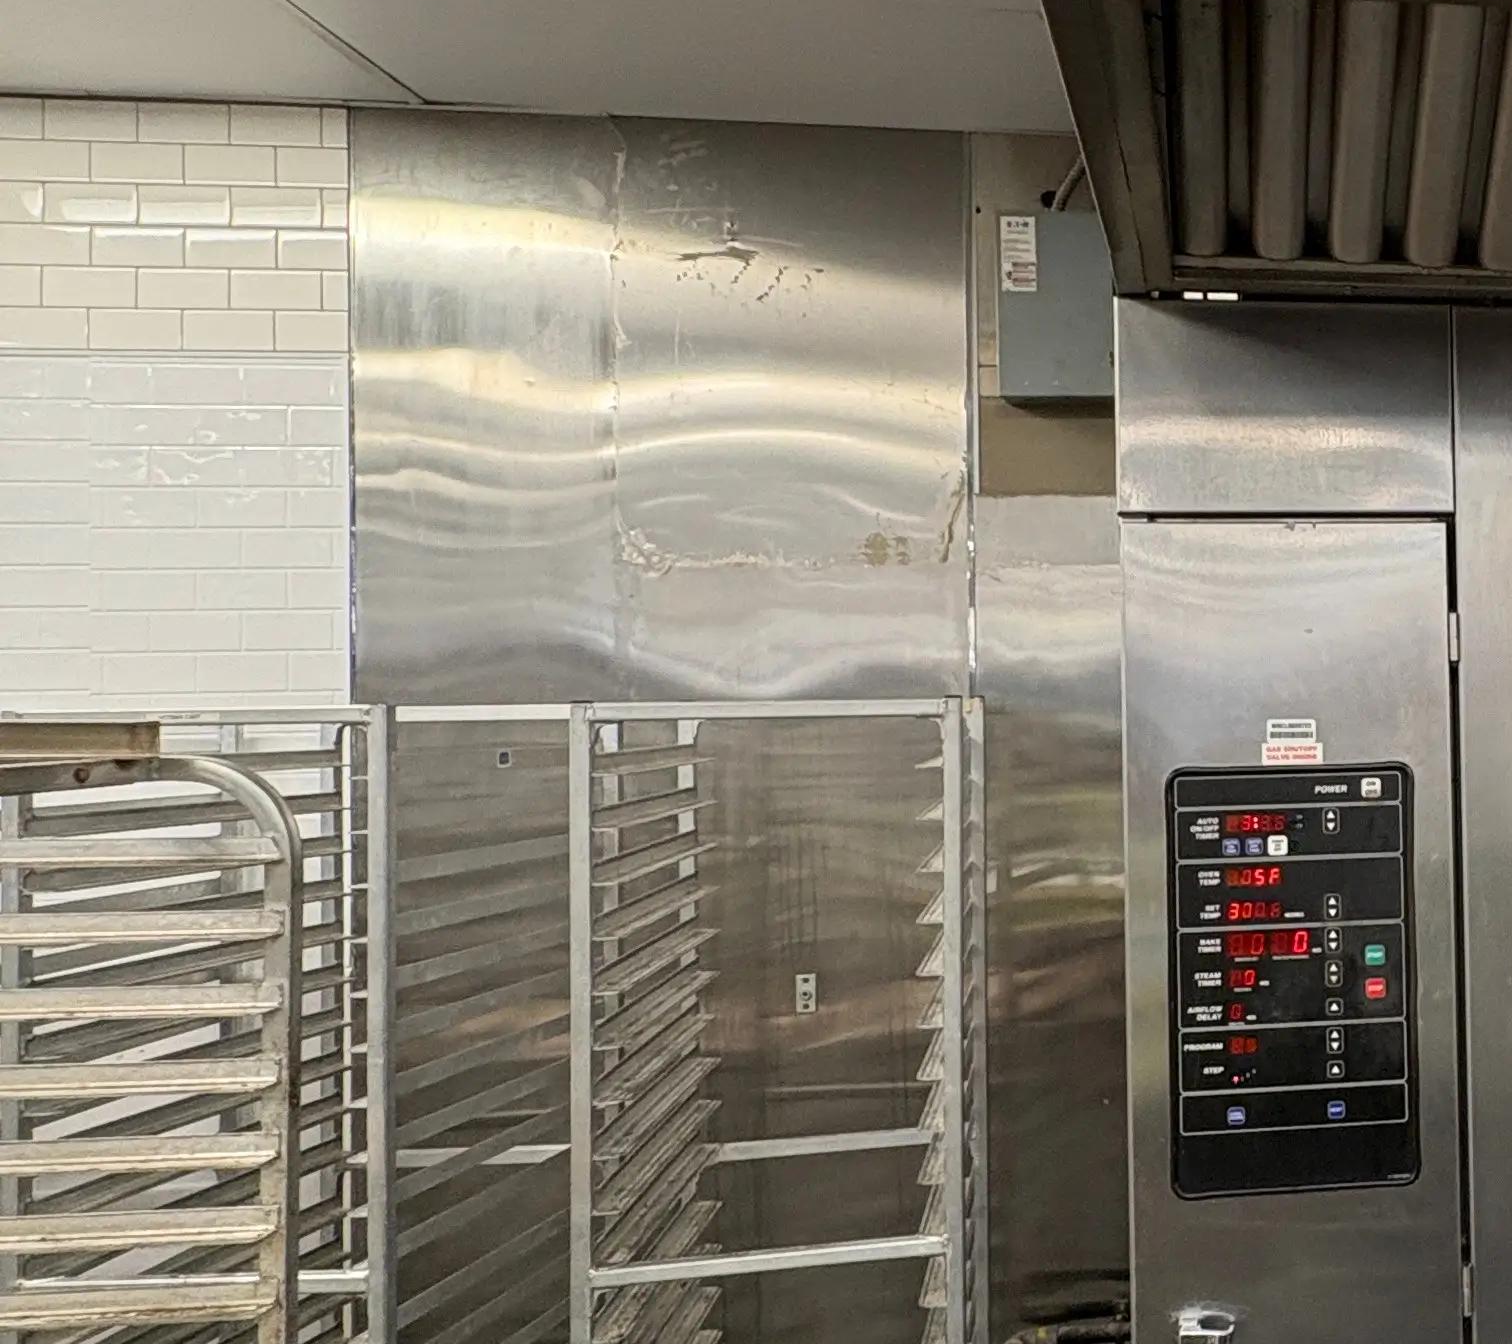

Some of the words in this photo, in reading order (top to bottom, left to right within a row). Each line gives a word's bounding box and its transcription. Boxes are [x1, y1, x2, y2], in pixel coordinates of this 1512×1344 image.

[1314, 784, 1348, 794] POWER
[1197, 817, 1219, 825] AUTO
[1205, 904, 1220, 912] SET
[1199, 938, 1221, 946] BAKE
[1194, 972, 1222, 980] STEAM
[1187, 1006, 1223, 1014] AIRFLOW
[1196, 1013, 1222, 1021] DELAY
[1184, 1042, 1223, 1051] PROGRAM
[1203, 1066, 1224, 1074] STEP
